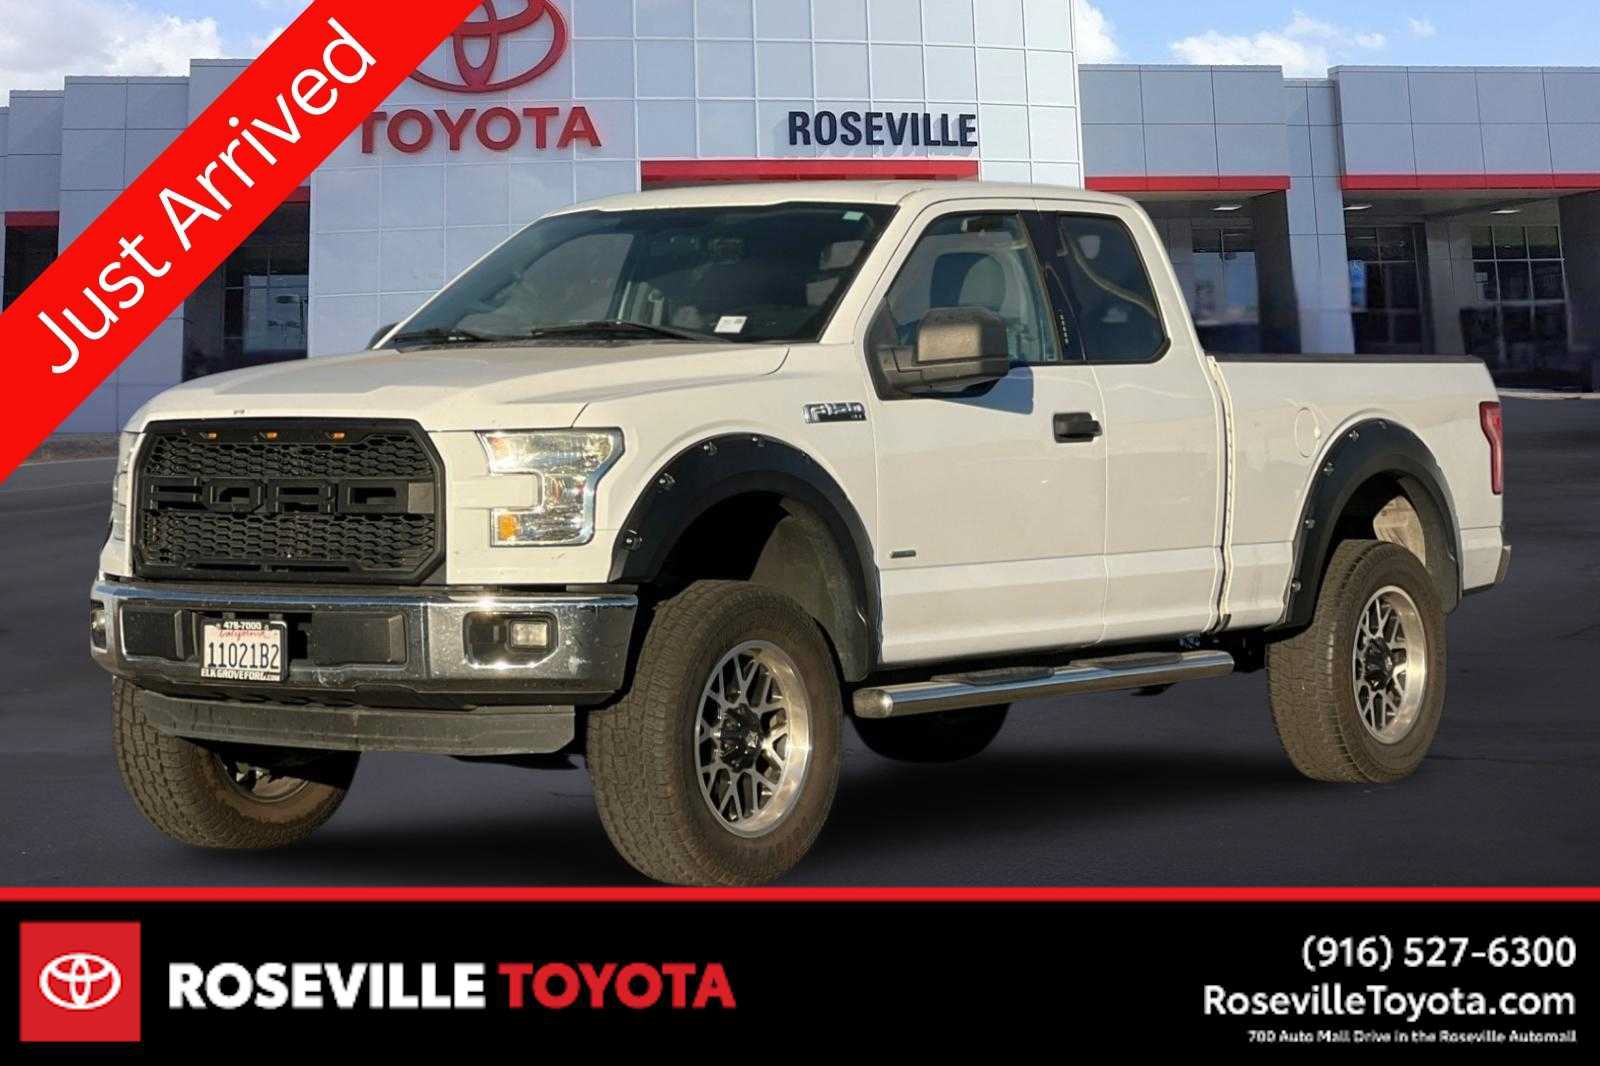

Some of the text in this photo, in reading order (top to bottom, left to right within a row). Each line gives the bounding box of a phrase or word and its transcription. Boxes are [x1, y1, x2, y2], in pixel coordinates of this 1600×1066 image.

[361, 106, 602, 154] TOYOTA
[788, 111, 978, 147] ROSEVILLE
[208, 642, 280, 669] 11021B2
